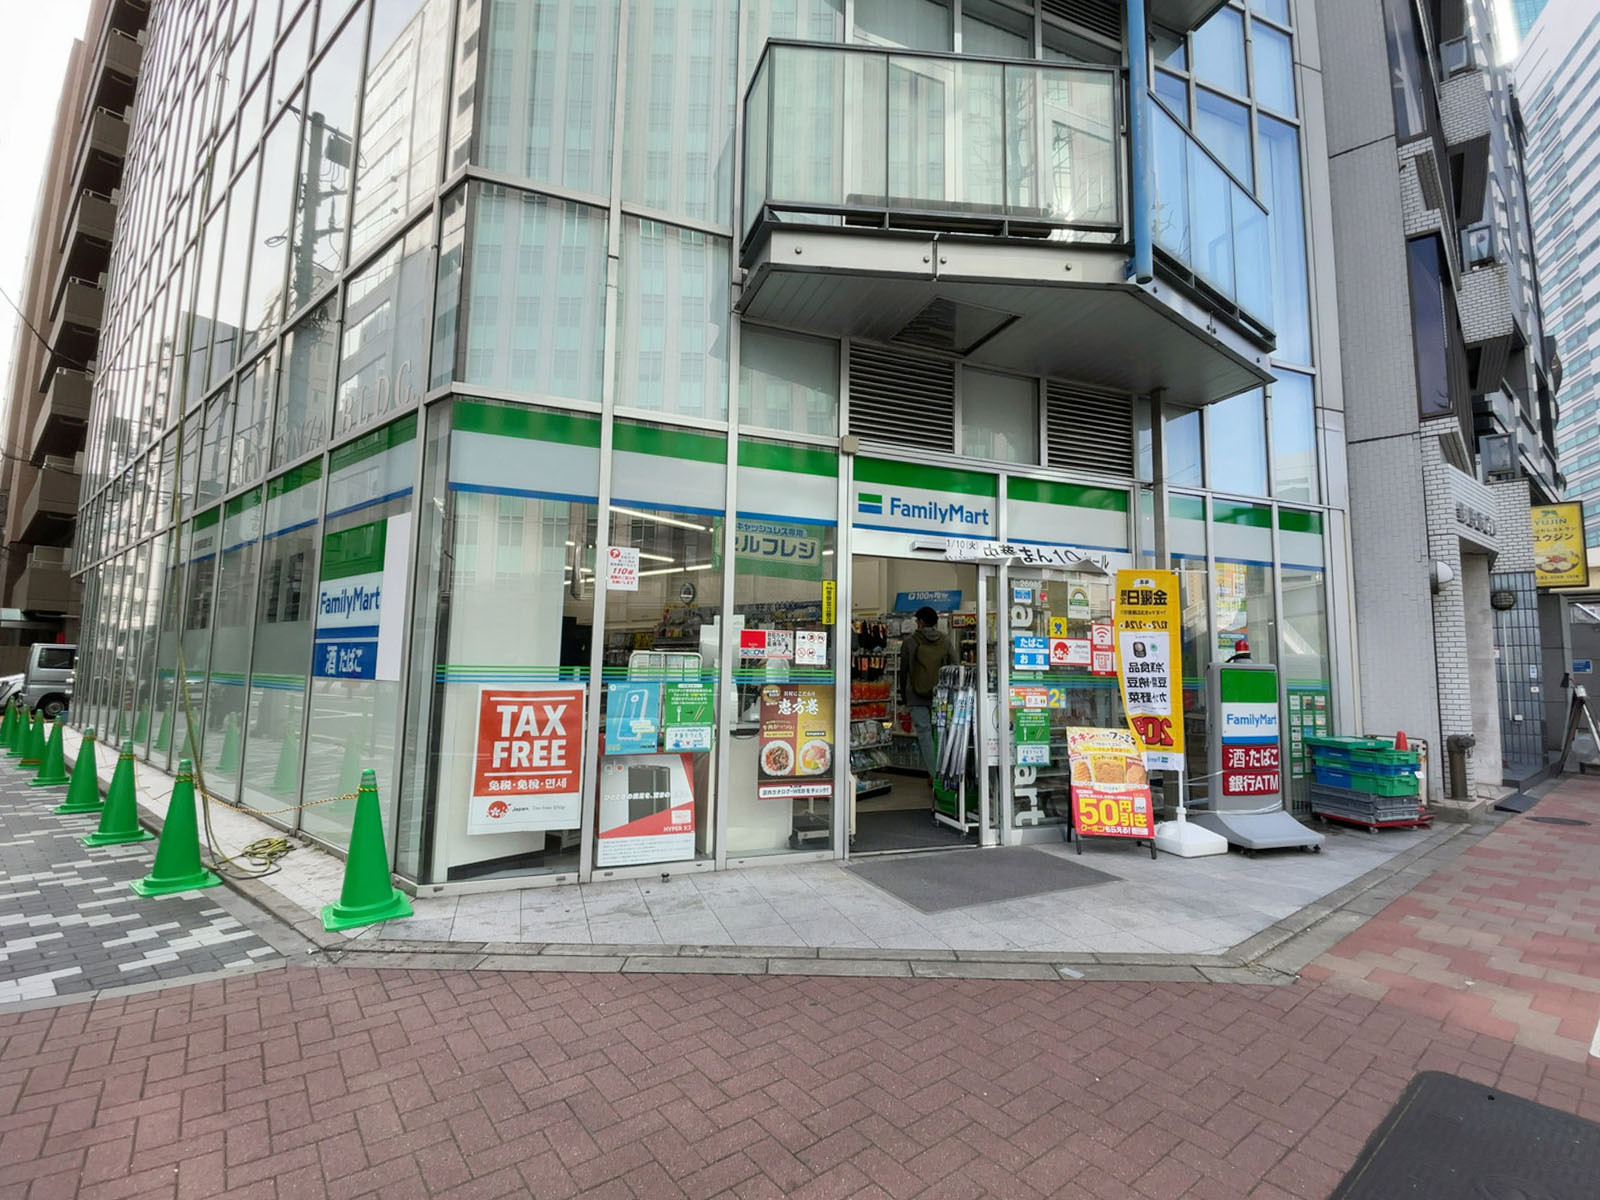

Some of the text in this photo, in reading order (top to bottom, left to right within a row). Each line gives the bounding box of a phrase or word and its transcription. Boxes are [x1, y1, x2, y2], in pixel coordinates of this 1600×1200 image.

[890, 497, 989, 526] FamilyMart
[735, 534, 817, 560] ルフレジ
[320, 585, 381, 620] FamilyMart
[1020, 638, 1045, 648] たばこ
[325, 645, 364, 675] 酒 たばこ
[778, 697, 819, 716] 恵方巻
[496, 704, 568, 738] TAX
[1226, 713, 1277, 728] FamilyMart
[491, 738, 568, 769] FREE
[1228, 748, 1279, 768] 酒・たばこ
[1228, 774, 1279, 793] 銀行ATM
